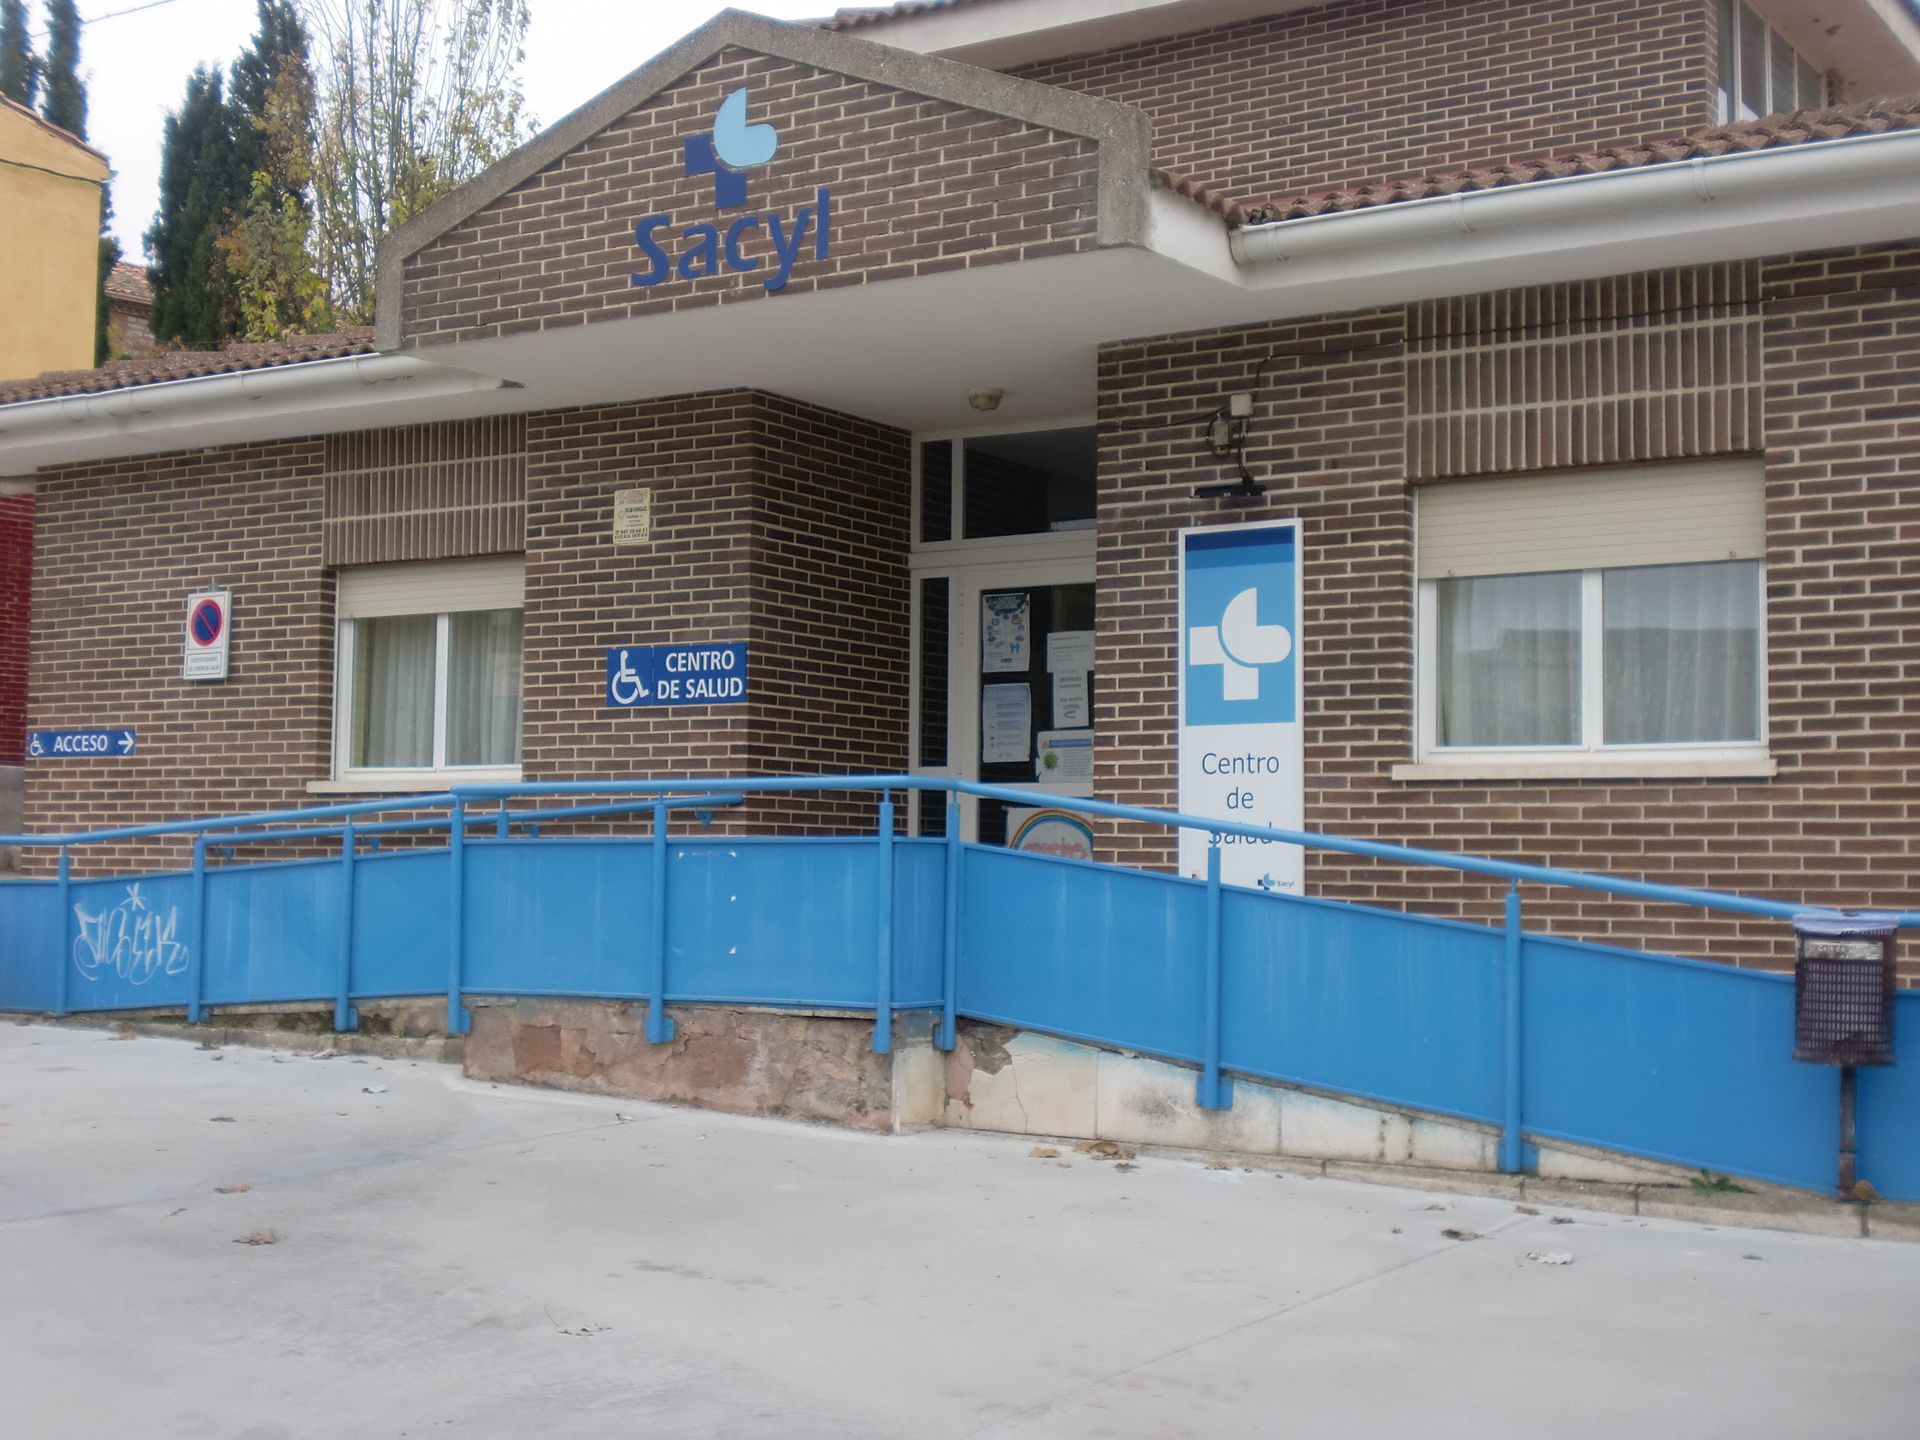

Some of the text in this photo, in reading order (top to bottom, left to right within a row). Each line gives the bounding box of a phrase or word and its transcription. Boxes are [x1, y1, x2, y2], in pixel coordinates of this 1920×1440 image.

[631, 188, 831, 292] Sacyl
[665, 650, 735, 673] CENTRO
[657, 677, 743, 700] DE SALUD
[53, 734, 108, 753] ACCESO
[1201, 752, 1280, 775] Centro
[1226, 786, 1254, 810] de
